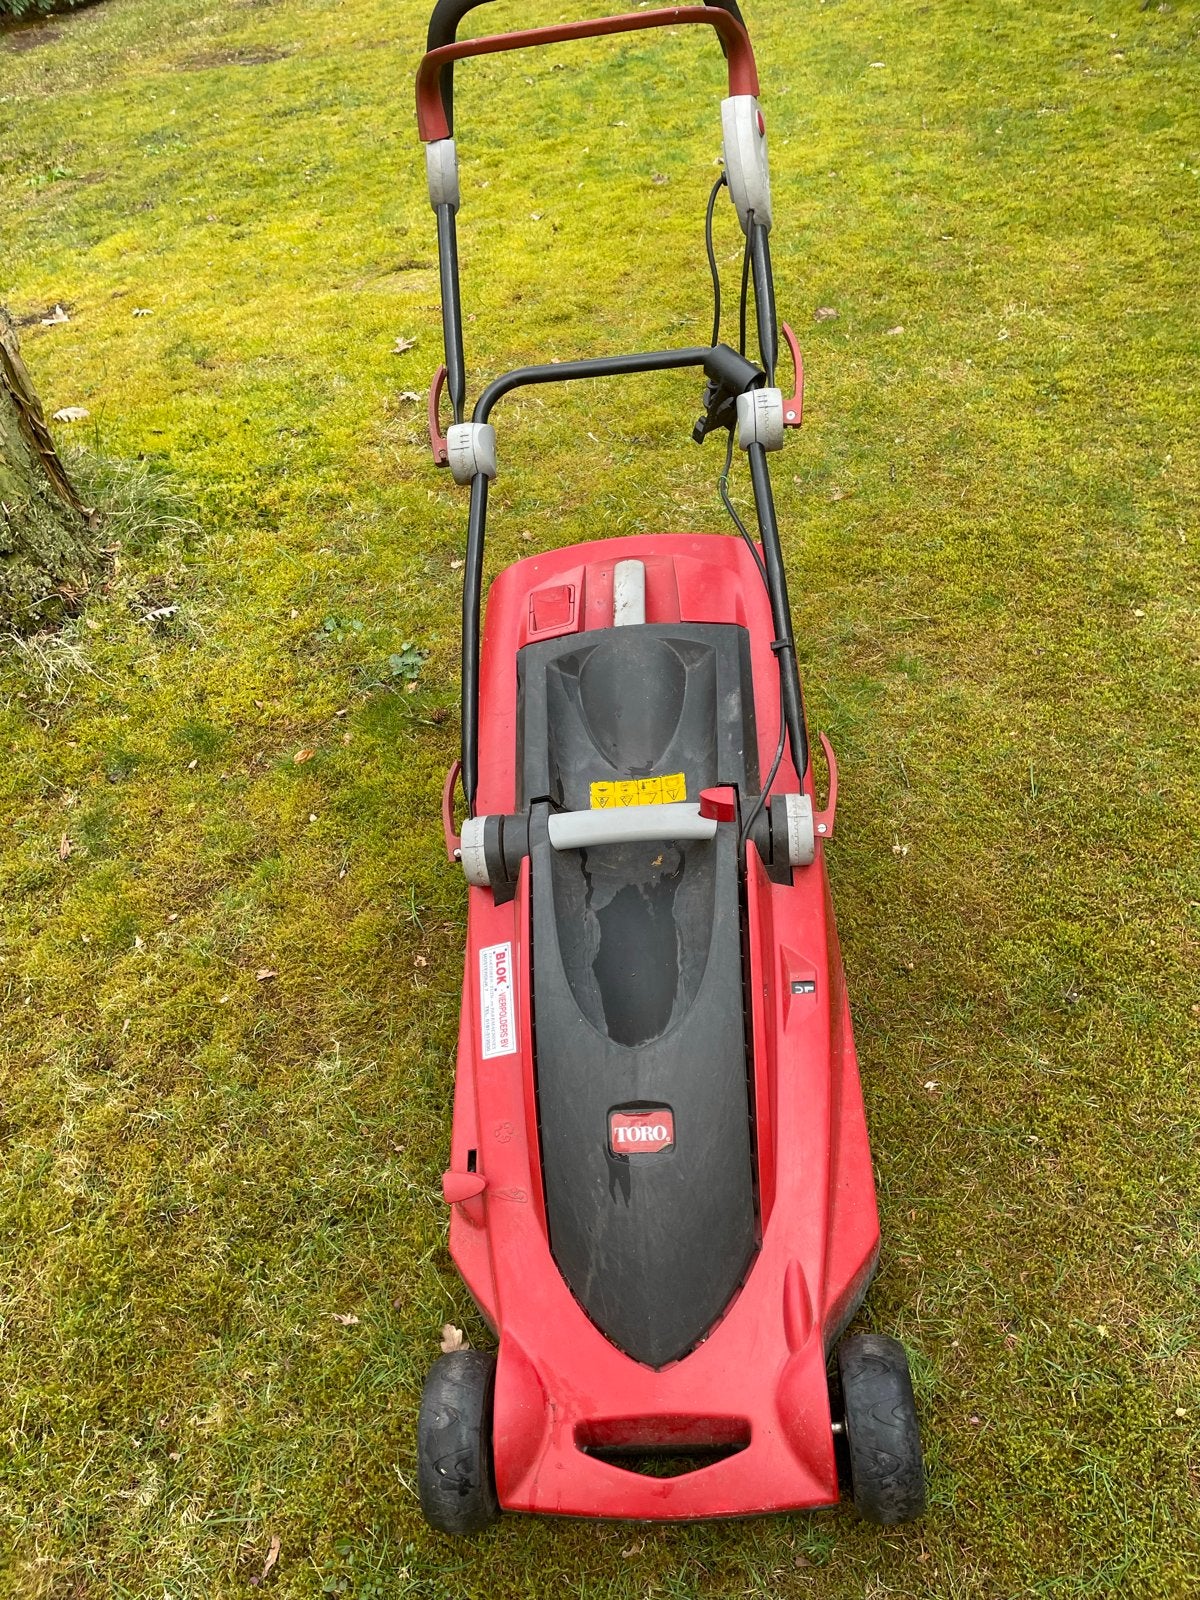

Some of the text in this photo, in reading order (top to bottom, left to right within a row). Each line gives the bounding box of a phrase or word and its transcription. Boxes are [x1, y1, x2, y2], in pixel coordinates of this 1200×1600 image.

[495, 951, 509, 1049] BLOK VIERPOLDERS BV
